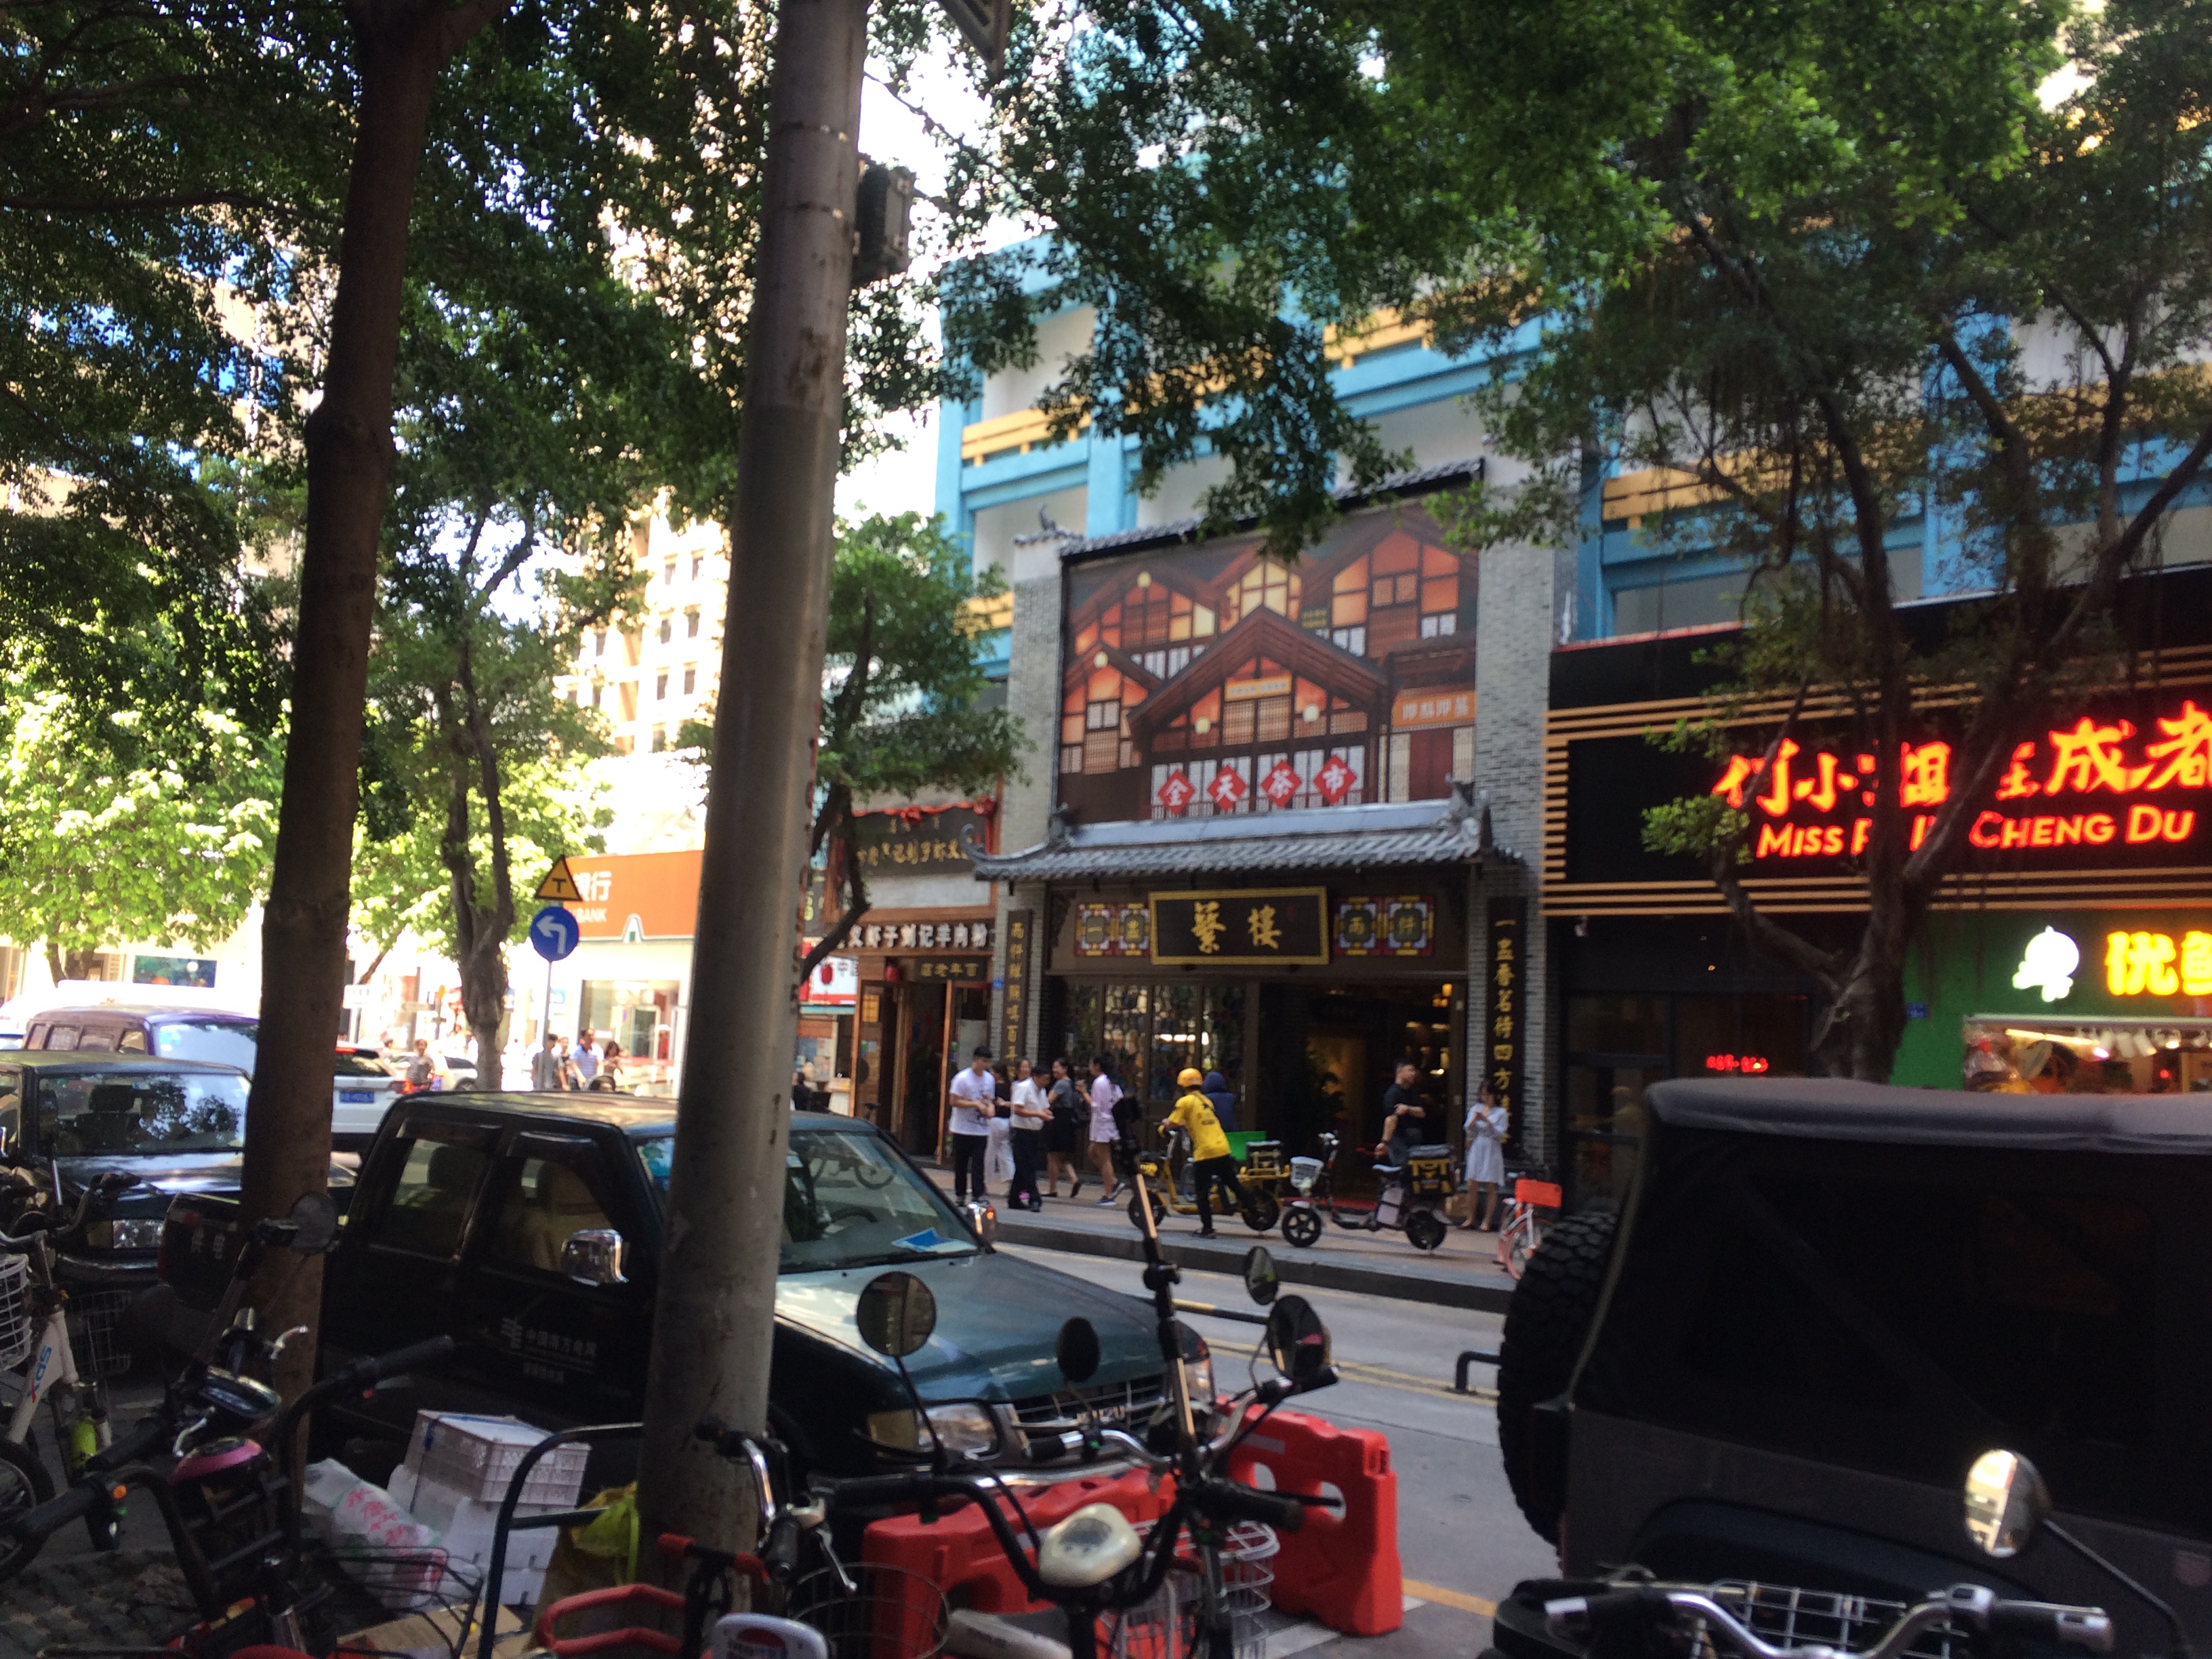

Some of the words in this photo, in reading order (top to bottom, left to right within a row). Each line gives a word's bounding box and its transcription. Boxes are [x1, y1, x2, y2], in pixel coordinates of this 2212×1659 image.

[1164, 763, 1348, 807] 全天茶市
[1968, 810, 2117, 851] CHENG
[2125, 804, 2196, 844] DU
[836, 922, 988, 949] 义虾子刘记羊肉粉
